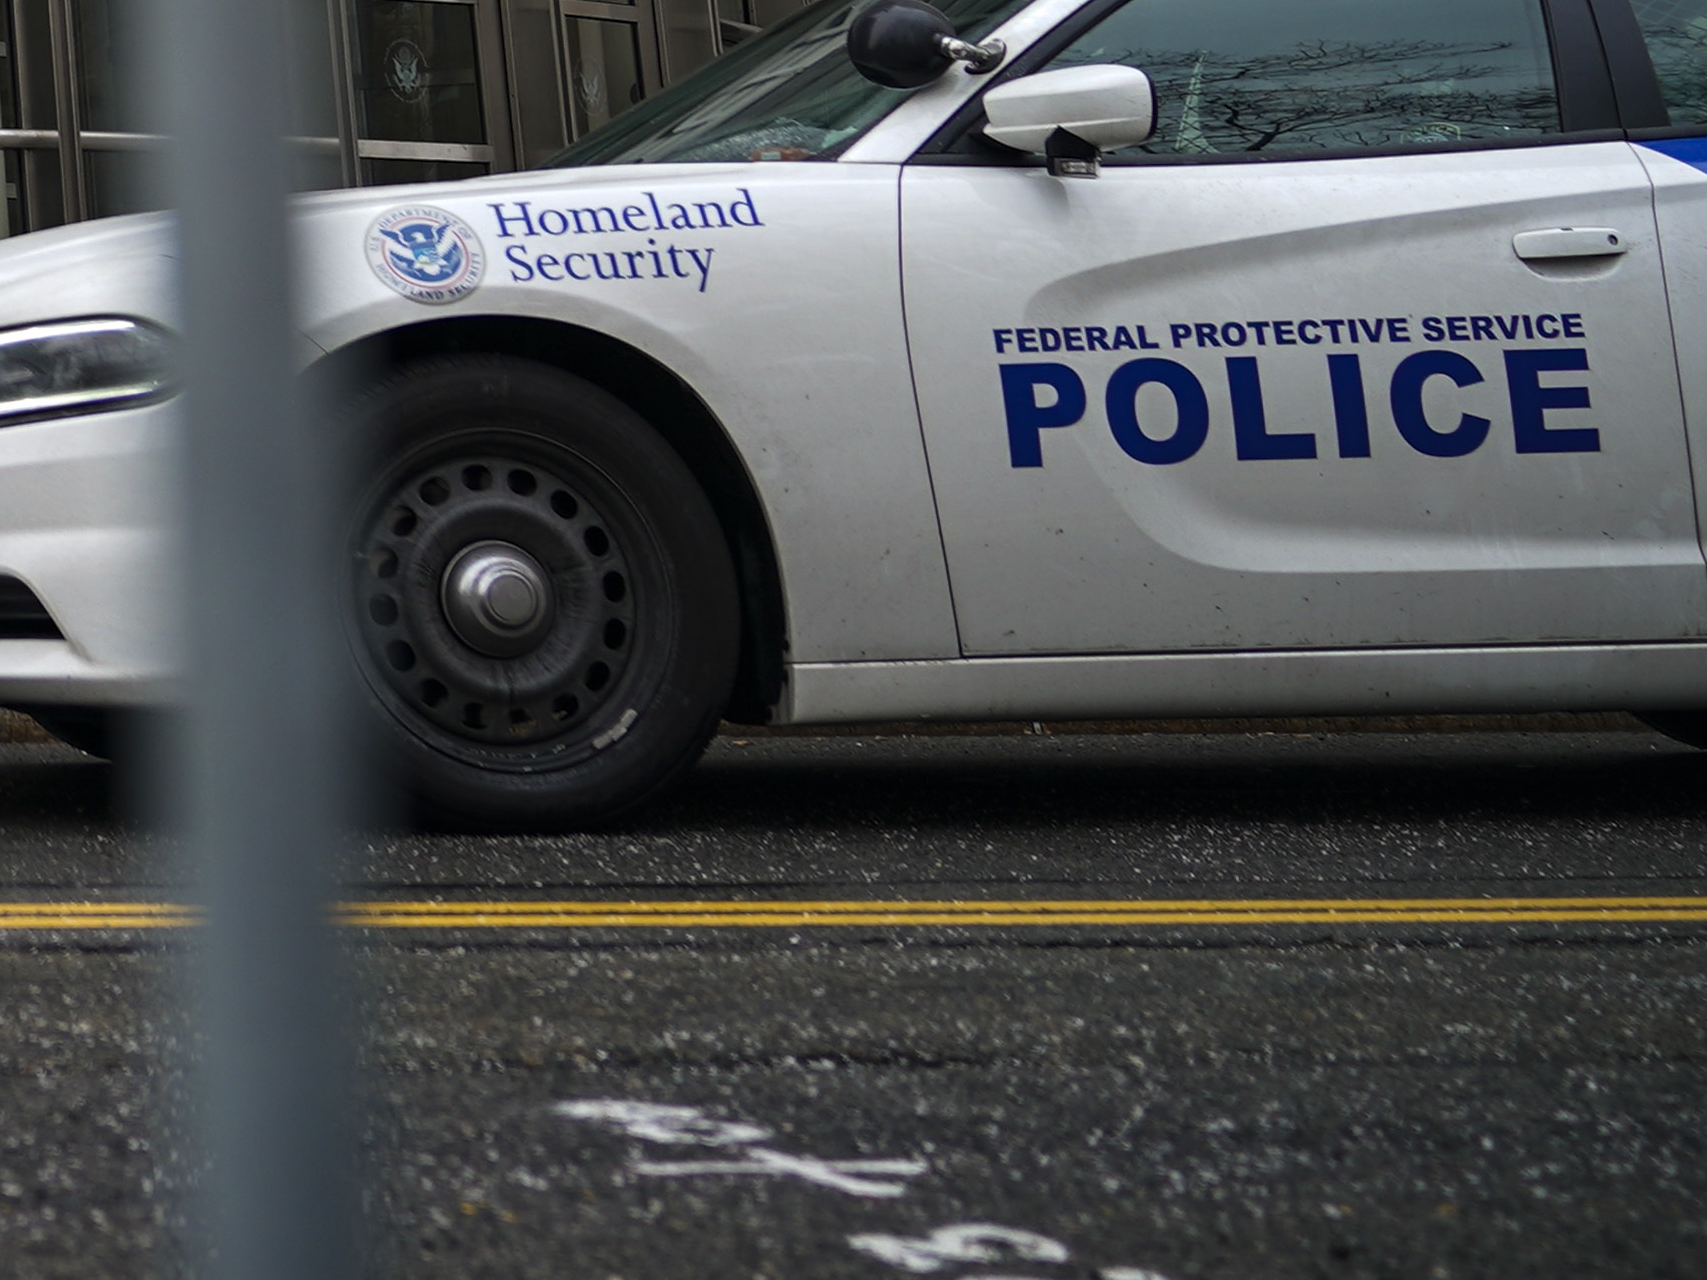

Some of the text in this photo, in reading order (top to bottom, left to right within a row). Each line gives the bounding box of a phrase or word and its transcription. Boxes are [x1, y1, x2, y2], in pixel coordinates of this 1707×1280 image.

[486, 188, 765, 238] Homeland
[504, 238, 716, 292] Security
[993, 312, 1587, 353] FEDERAL PROTECTIVE SERVICE
[998, 347, 1602, 469] POLICE
